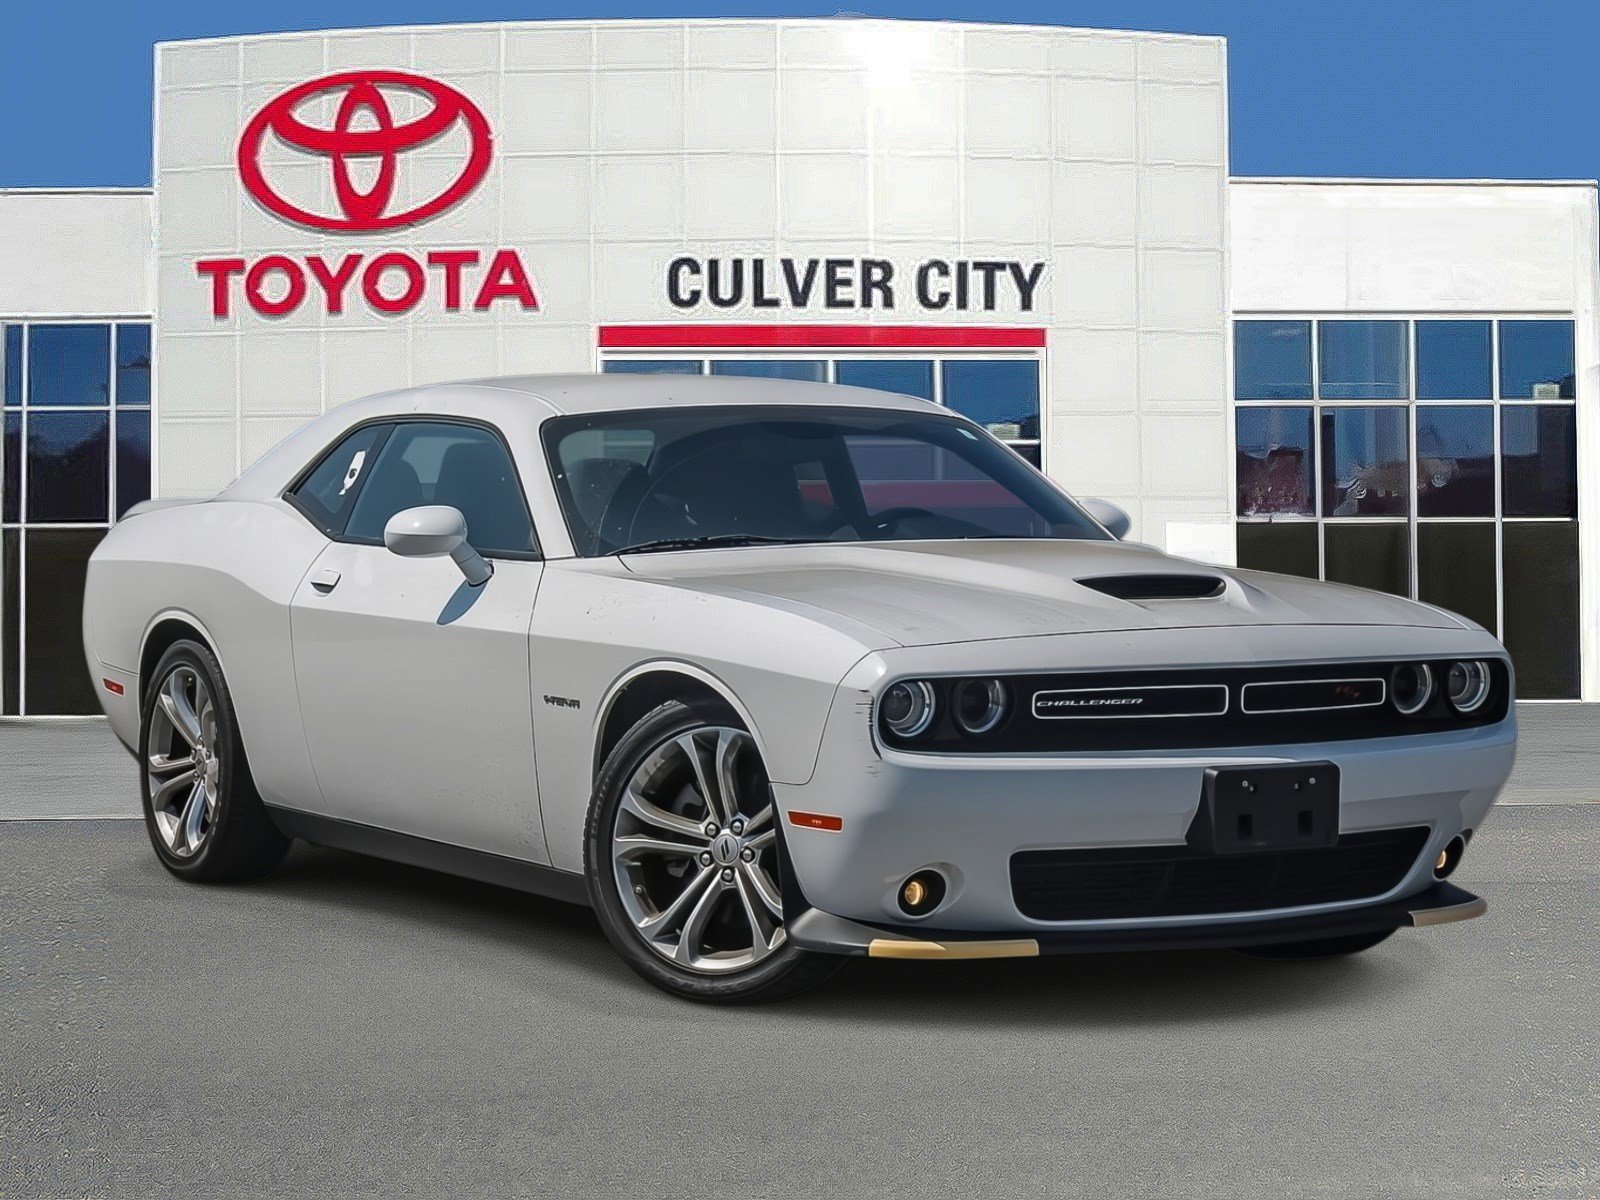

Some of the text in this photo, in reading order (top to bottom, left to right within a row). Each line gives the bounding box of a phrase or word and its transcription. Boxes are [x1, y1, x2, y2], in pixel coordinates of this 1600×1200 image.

[197, 250, 538, 318] TOYOTA
[667, 257, 1045, 312] CULVER CITY
[1036, 698, 1143, 707] CHALLENGER
